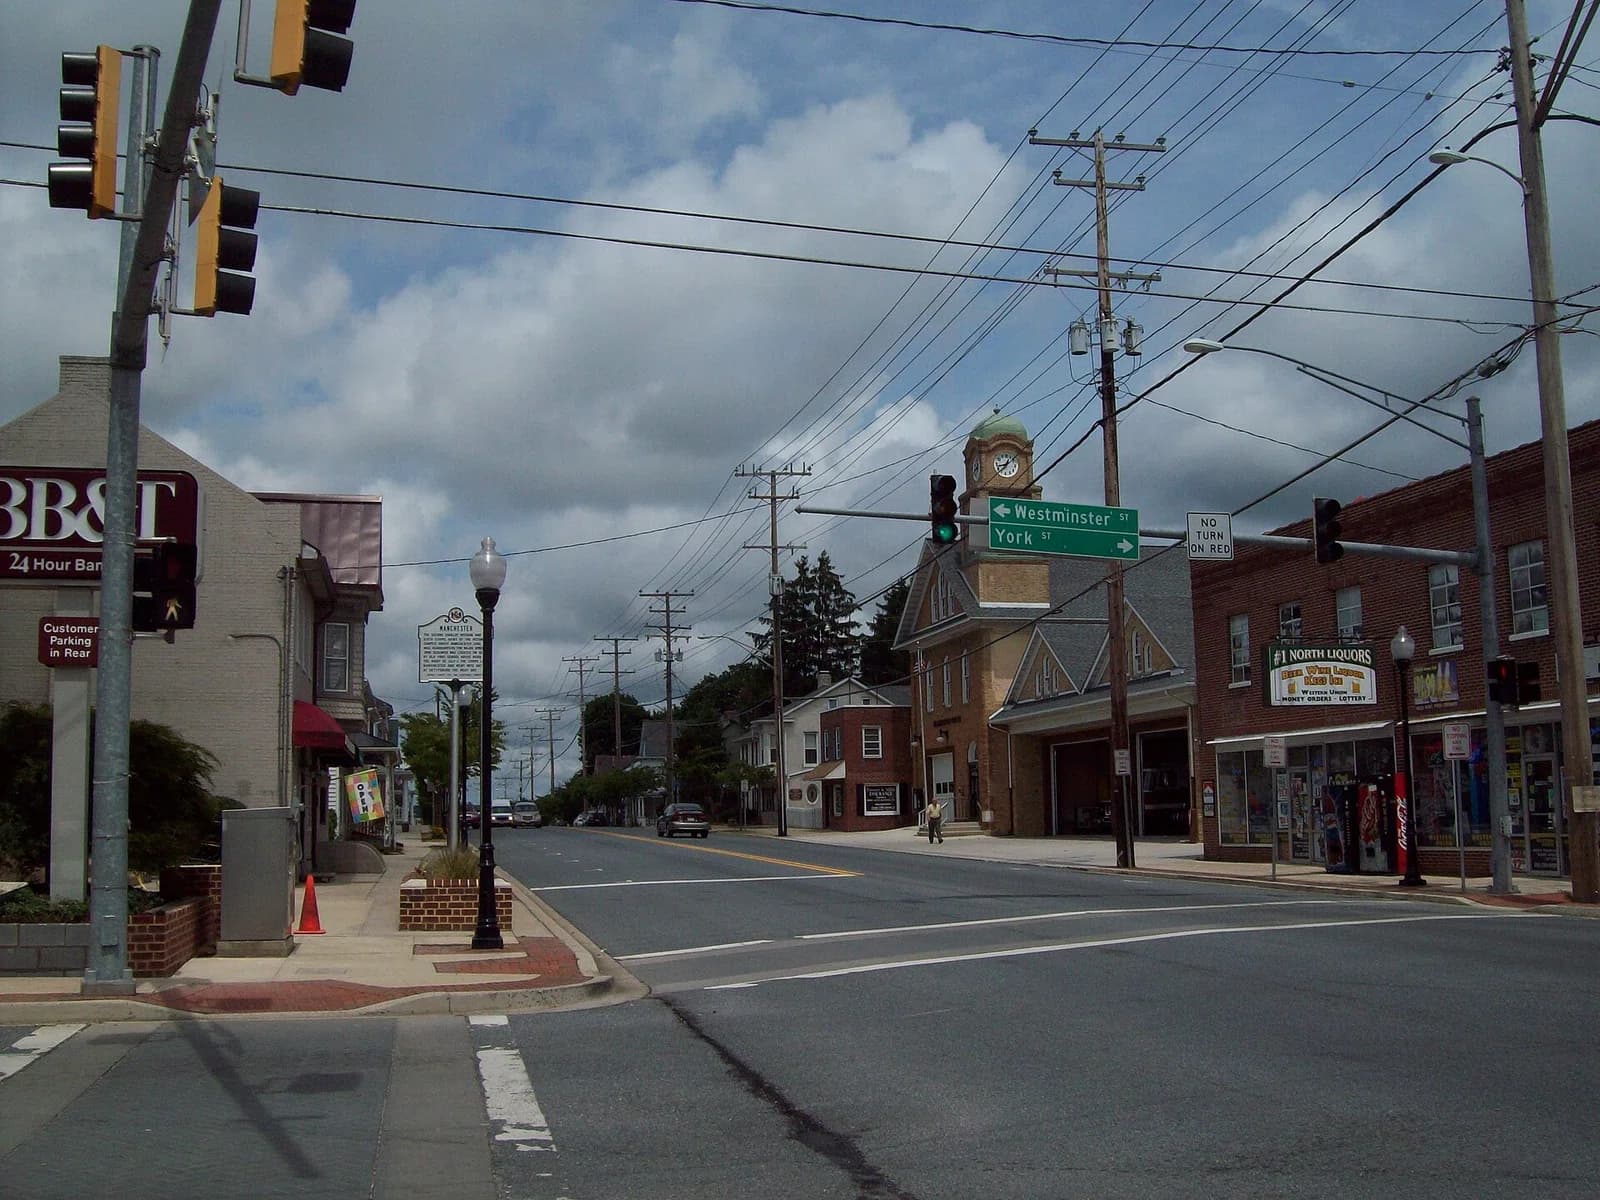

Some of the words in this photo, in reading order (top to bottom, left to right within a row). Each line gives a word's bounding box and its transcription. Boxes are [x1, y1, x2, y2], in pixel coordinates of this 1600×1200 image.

[1015, 503, 1111, 526] Westminster
[1120, 513, 1129, 521] ST
[1201, 518, 1217, 527] NO
[995, 528, 1032, 545] York
[1042, 532, 1051, 540] ST
[1196, 531, 1223, 540] TURN
[1191, 543, 1204, 553] ON
[1210, 544, 1230, 553] RED
[9, 553, 29, 573] 24
[34, 559, 71, 571] Hour
[75, 559, 102, 571] Ban
[44, 623, 99, 633] Customer
[50, 636, 92, 648] Parking
[50, 648, 60, 657] in
[64, 648, 91, 658] Rear
[1273, 650, 1287, 665] #1
[1289, 649, 1325, 662] NORTH
[1327, 649, 1371, 665] LIQUORS
[357, 783, 369, 813] OPEN
